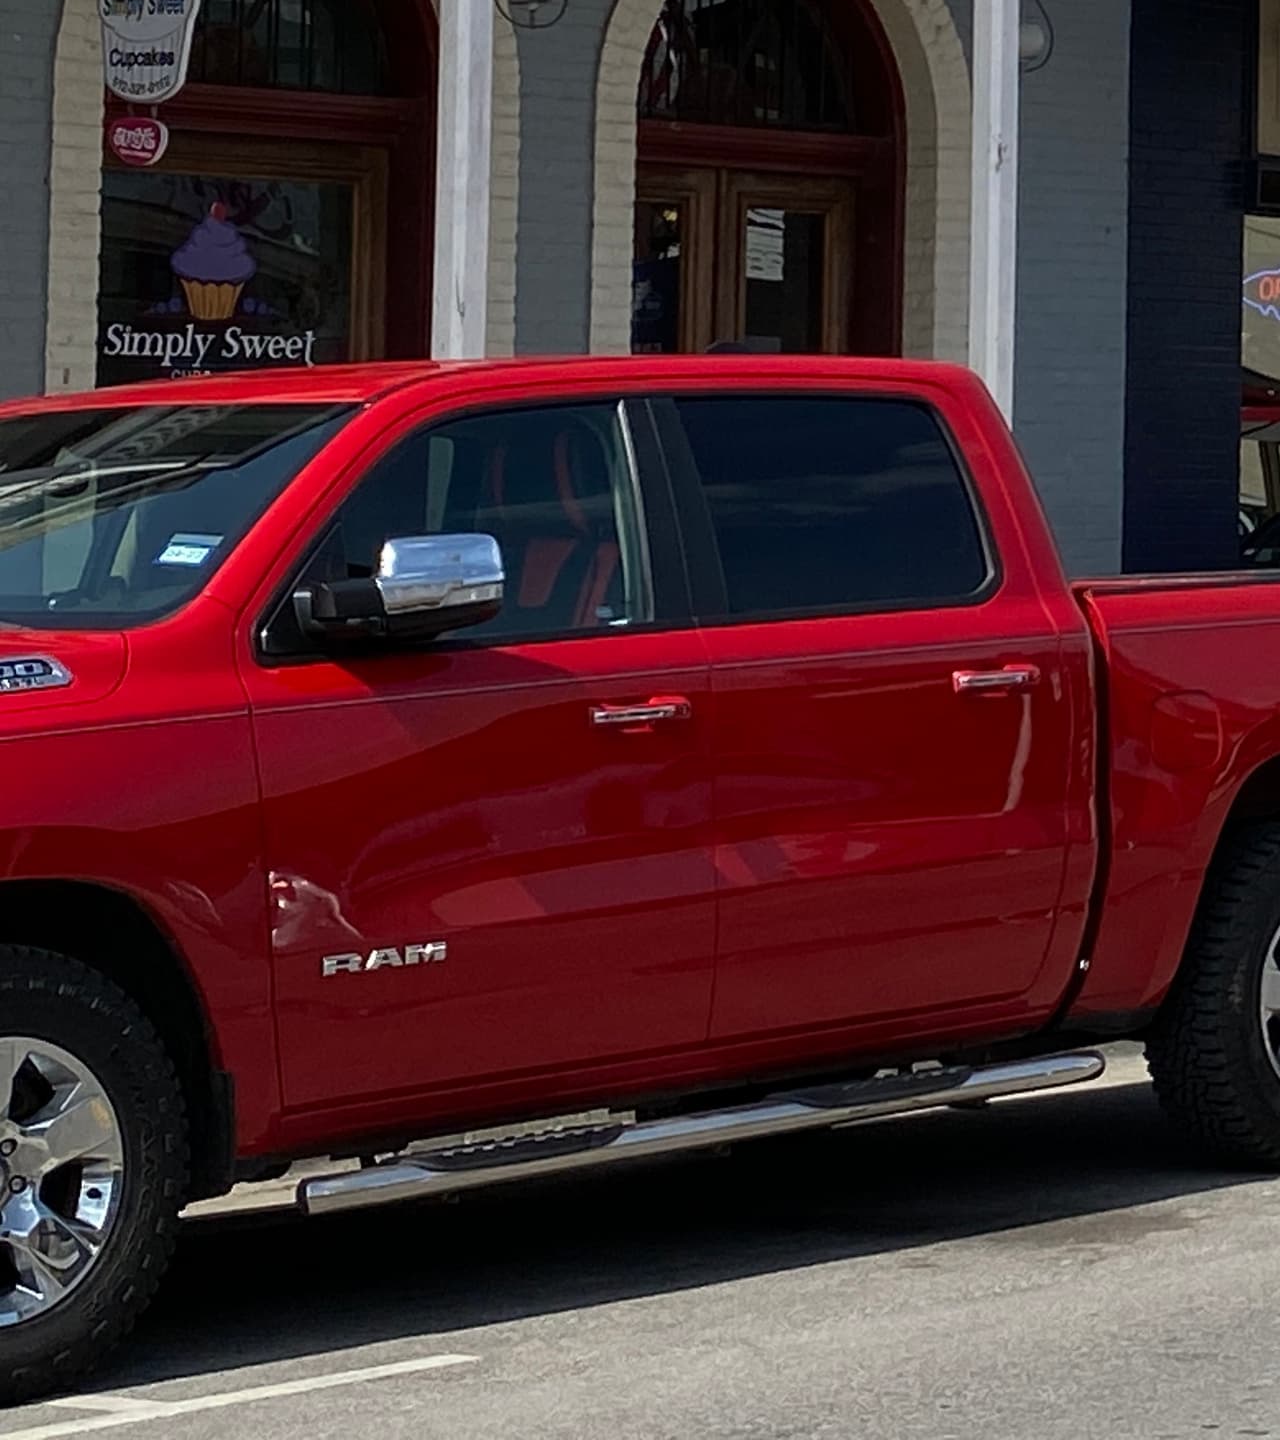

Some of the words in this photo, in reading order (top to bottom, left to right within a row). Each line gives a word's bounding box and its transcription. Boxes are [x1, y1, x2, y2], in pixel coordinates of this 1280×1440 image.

[109, 47, 175, 71] Cupcakes
[103, 323, 216, 367] Simply
[221, 326, 316, 368] Sweet
[321, 940, 447, 977] RAM
